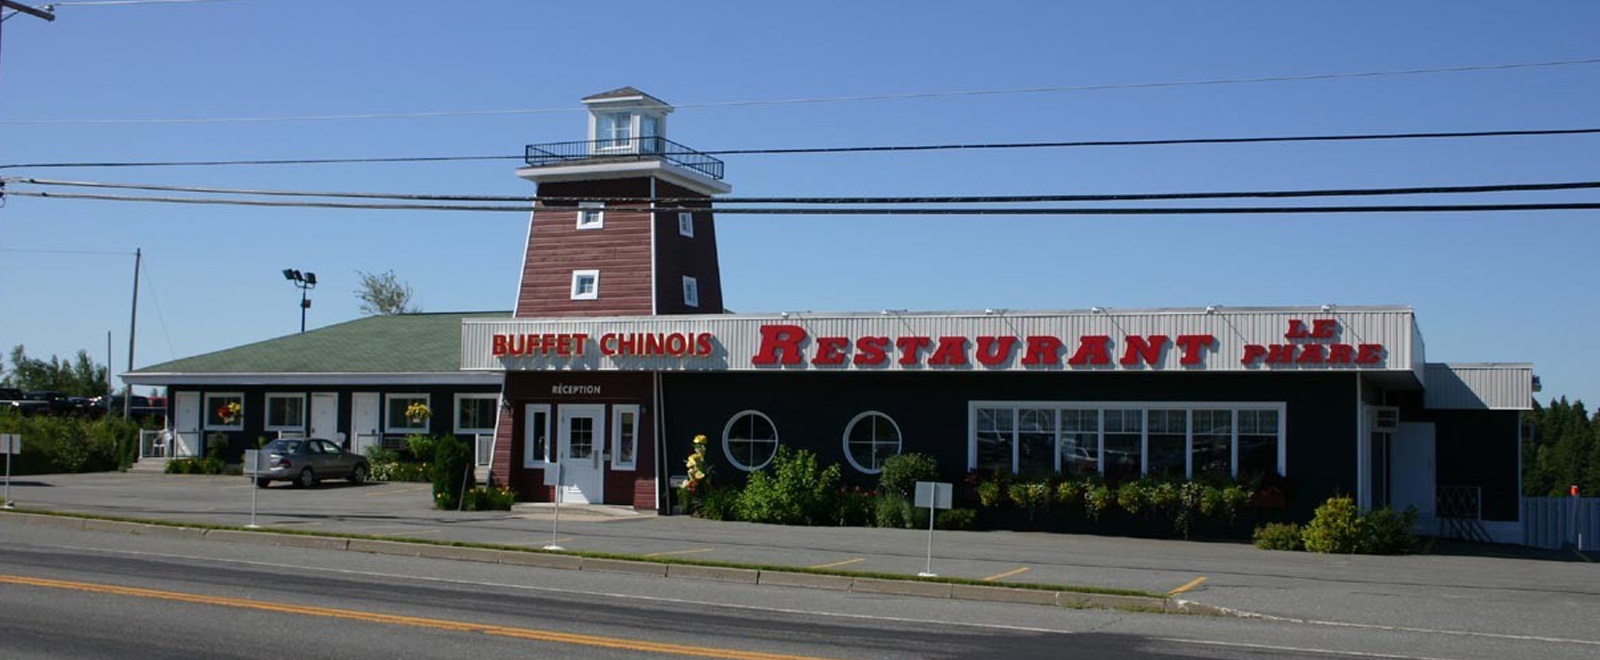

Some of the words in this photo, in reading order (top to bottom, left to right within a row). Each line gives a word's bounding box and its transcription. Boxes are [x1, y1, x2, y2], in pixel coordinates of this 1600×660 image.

[1284, 319, 1336, 338] LE
[492, 333, 588, 357] BUFFET
[599, 332, 713, 357] CHINOIS
[752, 325, 1213, 366] RESTAURANT
[1241, 344, 1383, 364] PHARE
[552, 383, 600, 395] RÉCEPTION
